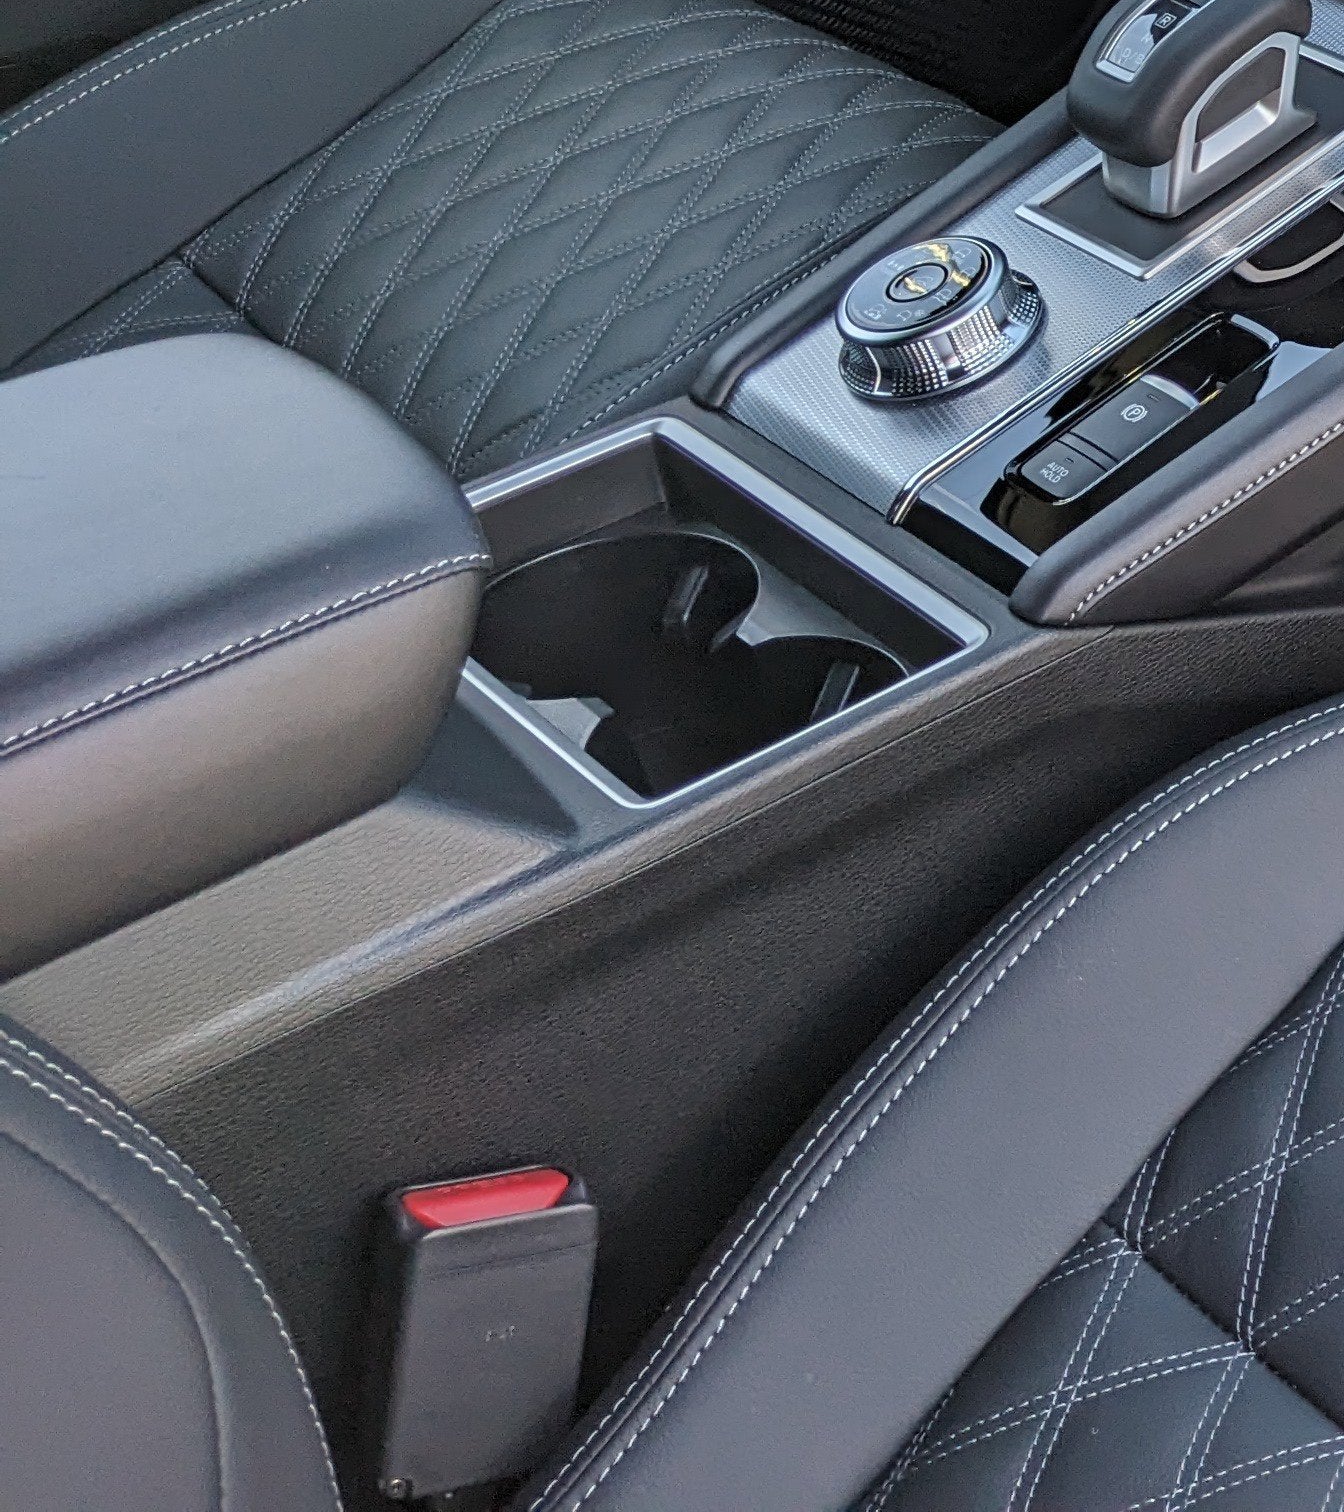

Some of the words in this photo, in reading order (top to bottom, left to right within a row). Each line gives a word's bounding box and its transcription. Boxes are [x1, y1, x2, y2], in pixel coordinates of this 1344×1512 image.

[1158, 15, 1172, 27] R
[1040, 467, 1061, 483] HOLD
[1047, 461, 1069, 477] AUTO
